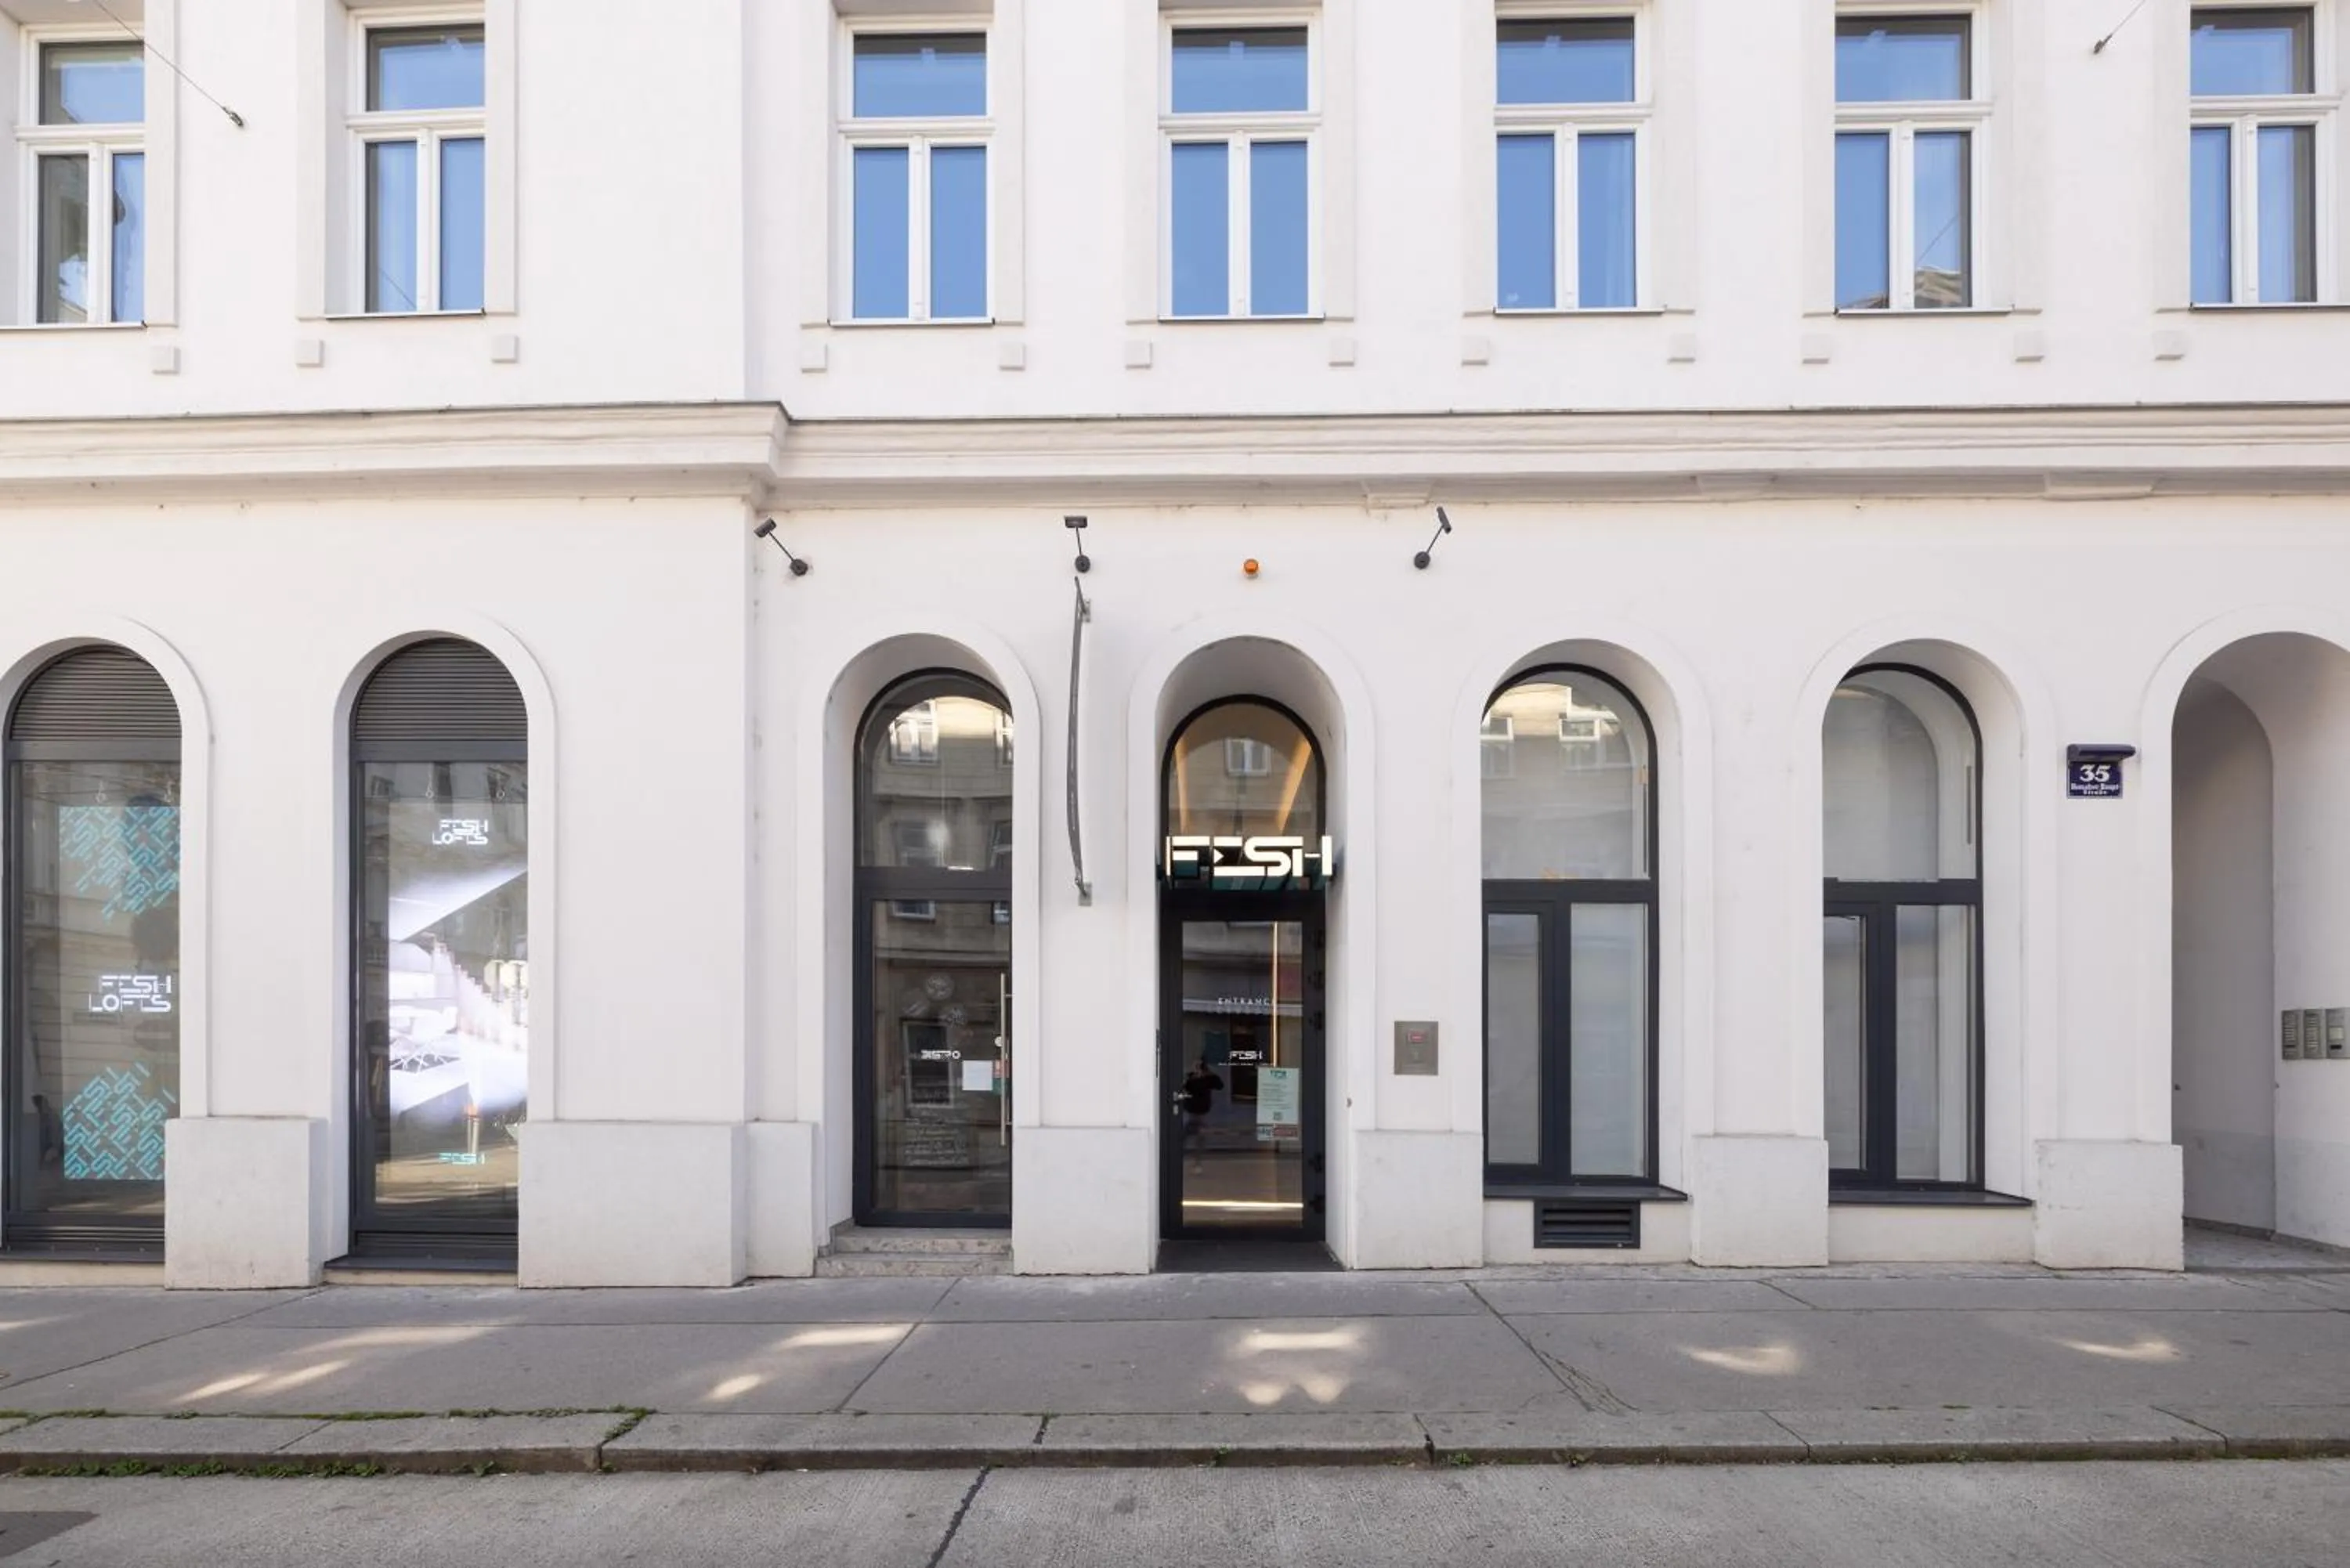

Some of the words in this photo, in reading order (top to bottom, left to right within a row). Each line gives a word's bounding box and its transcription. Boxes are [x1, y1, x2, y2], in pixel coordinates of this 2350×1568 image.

[2080, 764, 2111, 782] 35
[439, 819, 488, 833] FESH
[432, 831, 488, 845] LOFTS
[1166, 835, 1332, 876] FESH
[99, 975, 172, 993] FESH
[89, 993, 172, 1012] LOFTS
[1218, 997, 1271, 1006] ENTRANC
[1228, 1050, 1263, 1060] FESH
